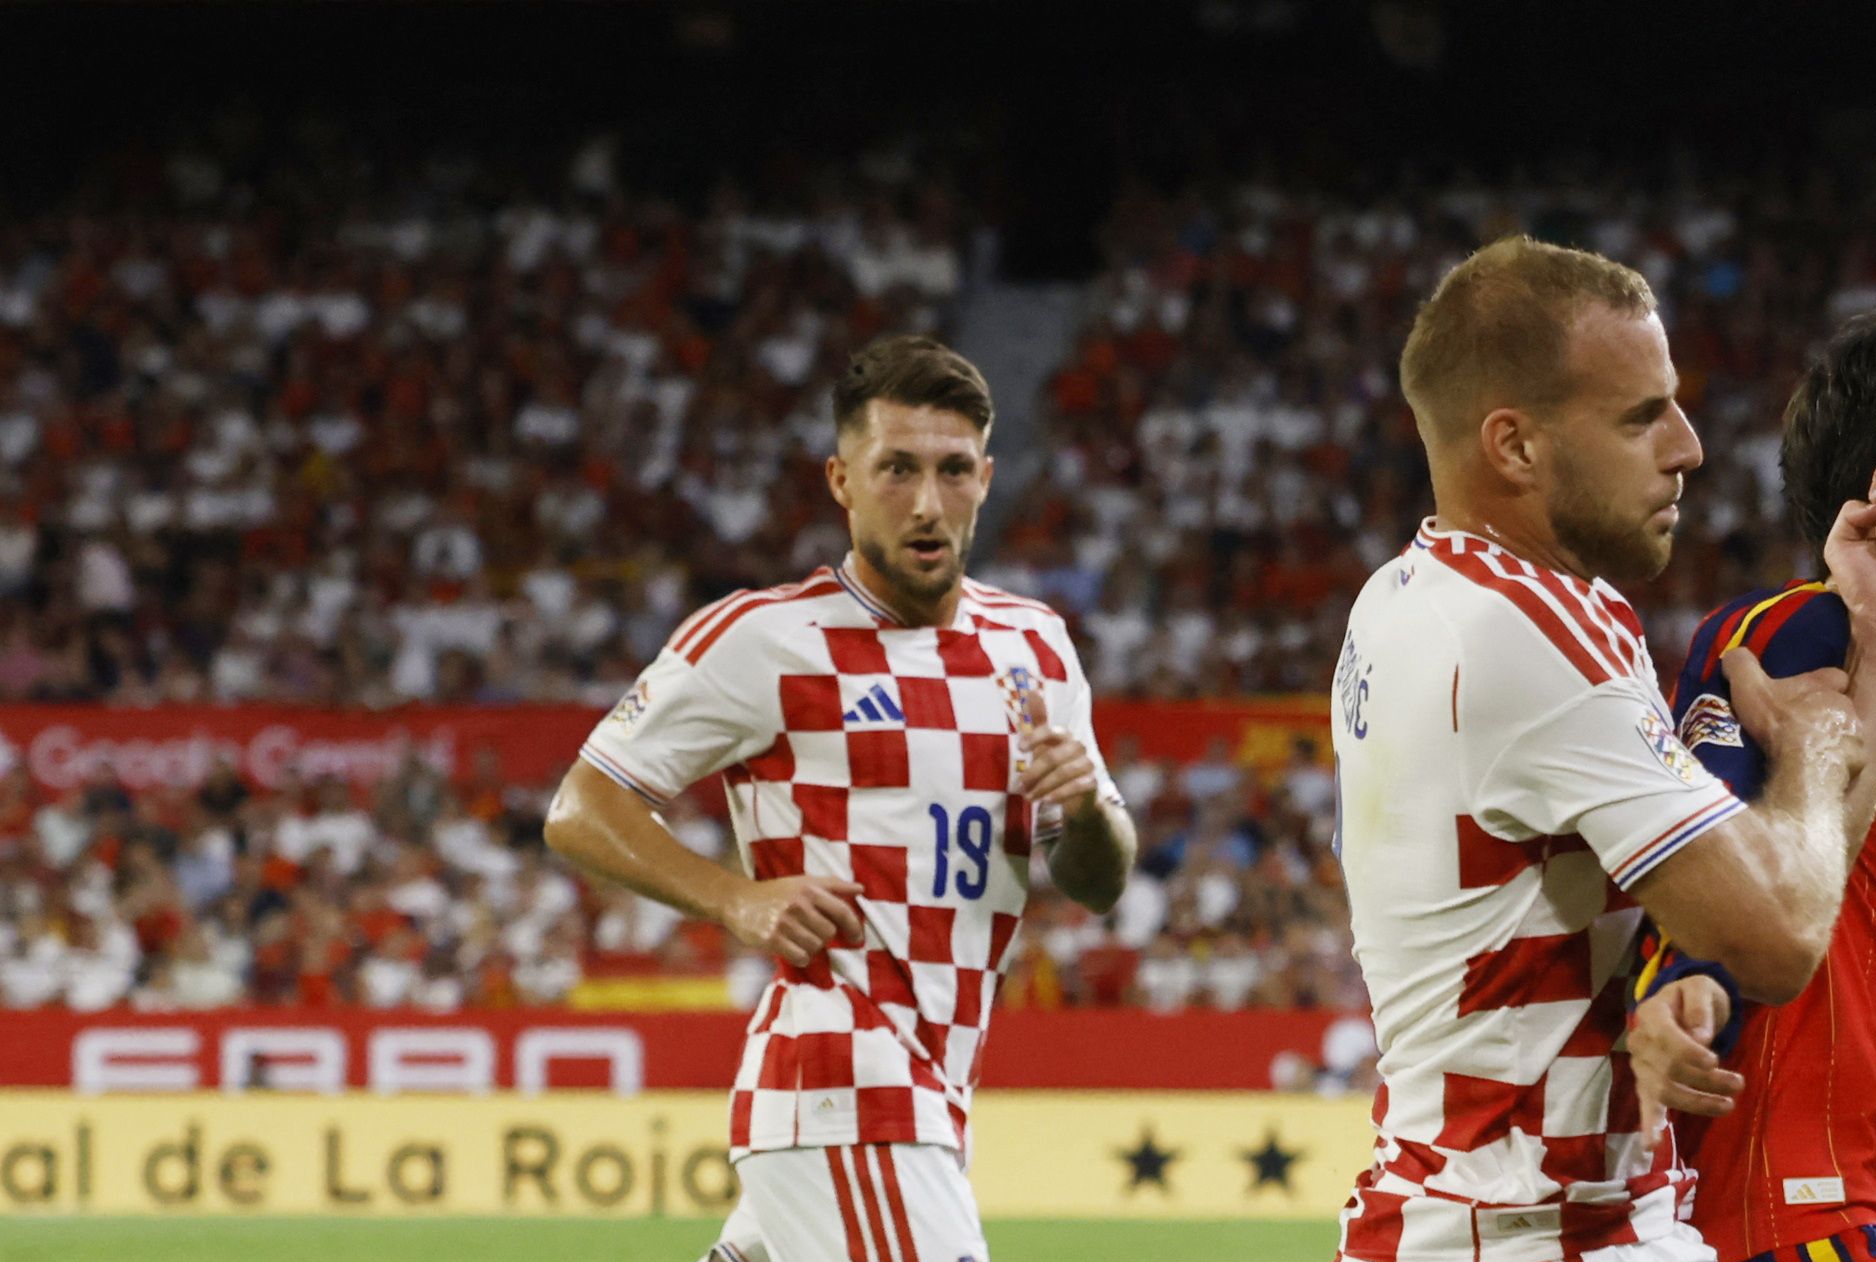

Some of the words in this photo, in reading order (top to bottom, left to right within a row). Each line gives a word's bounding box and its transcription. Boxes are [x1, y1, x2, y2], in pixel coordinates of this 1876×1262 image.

[928, 802, 992, 900] 19
[142, 1122, 270, 1203] de
[325, 1126, 445, 1204] La
